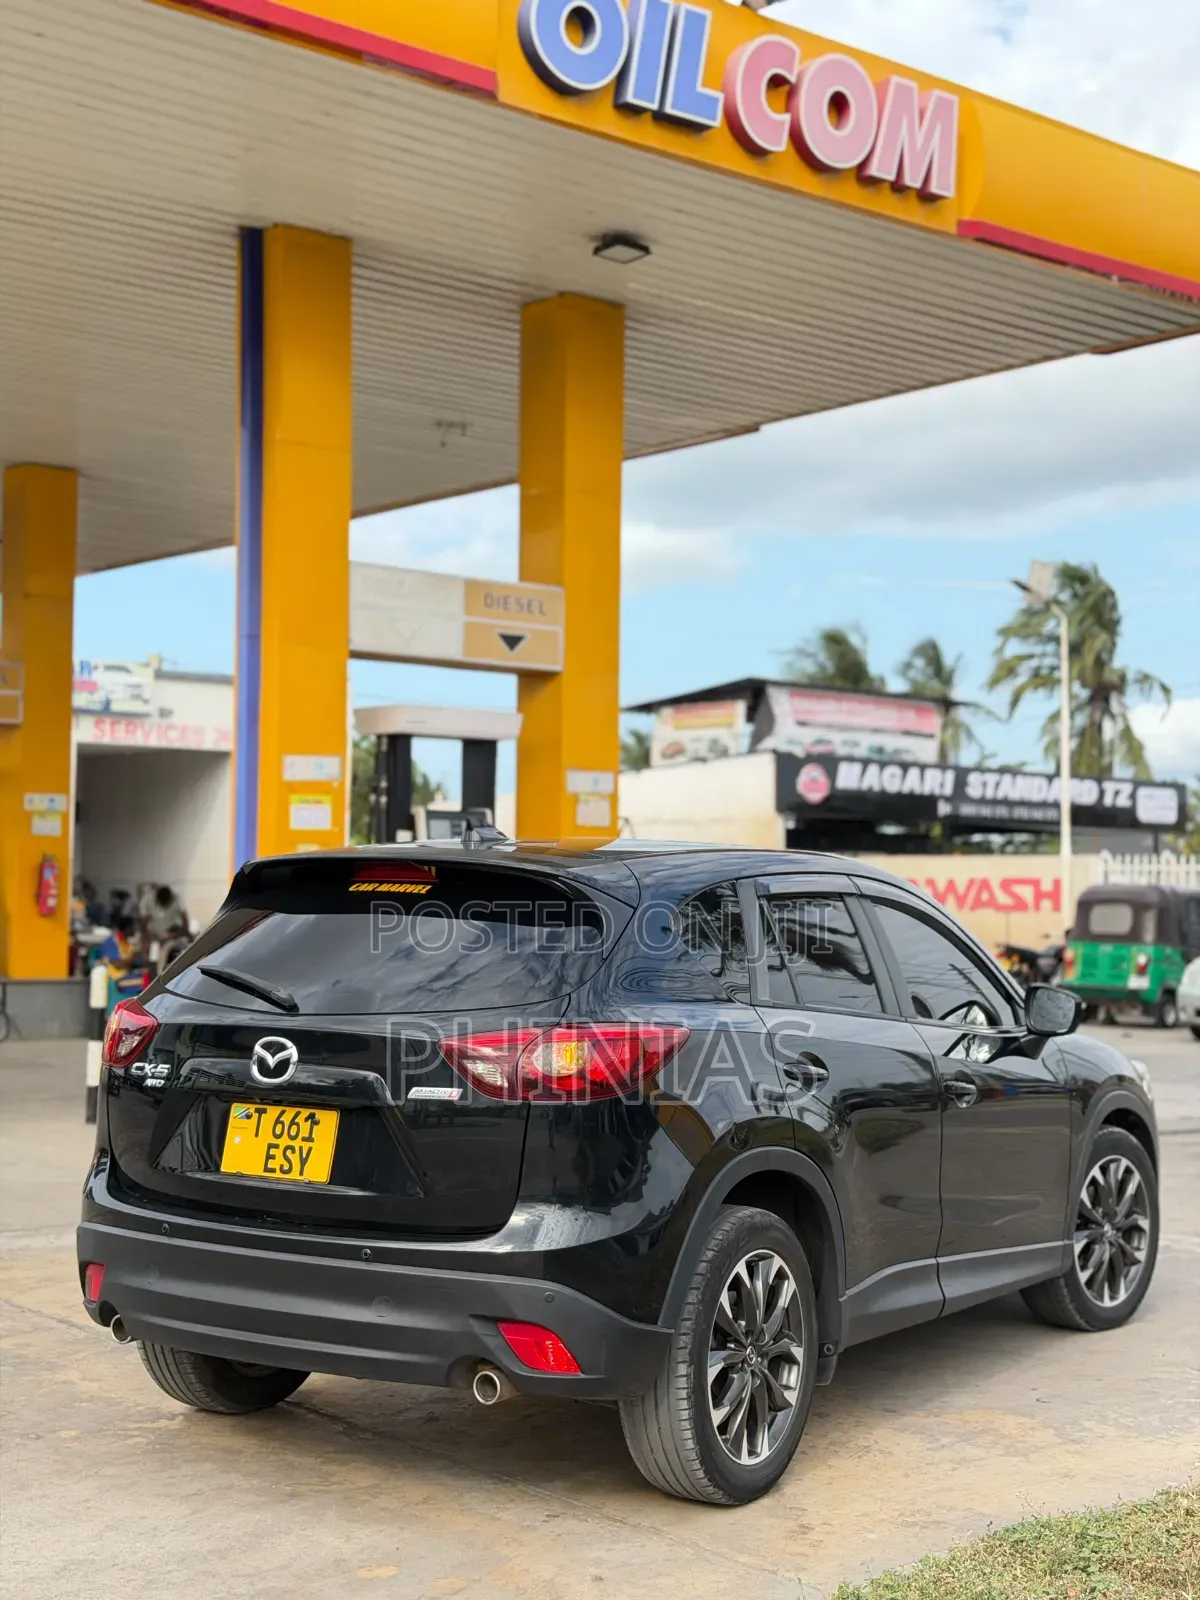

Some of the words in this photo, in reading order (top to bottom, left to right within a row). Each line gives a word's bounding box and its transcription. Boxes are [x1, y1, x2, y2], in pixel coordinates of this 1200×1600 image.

[483, 592, 547, 617] DIESEL
[91, 717, 206, 749] SERVICES
[835, 760, 956, 797] MAGARI
[964, 770, 1100, 806] STANDARD
[1101, 780, 1134, 808] TZ
[348, 882, 380, 892] CAR
[374, 883, 433, 894] MARVEL
[905, 876, 1062, 913] WASH
[142, 1078, 166, 1088] AWD
[254, 1107, 268, 1138] T
[271, 1109, 316, 1143] 661
[262, 1142, 313, 1177] ESY
